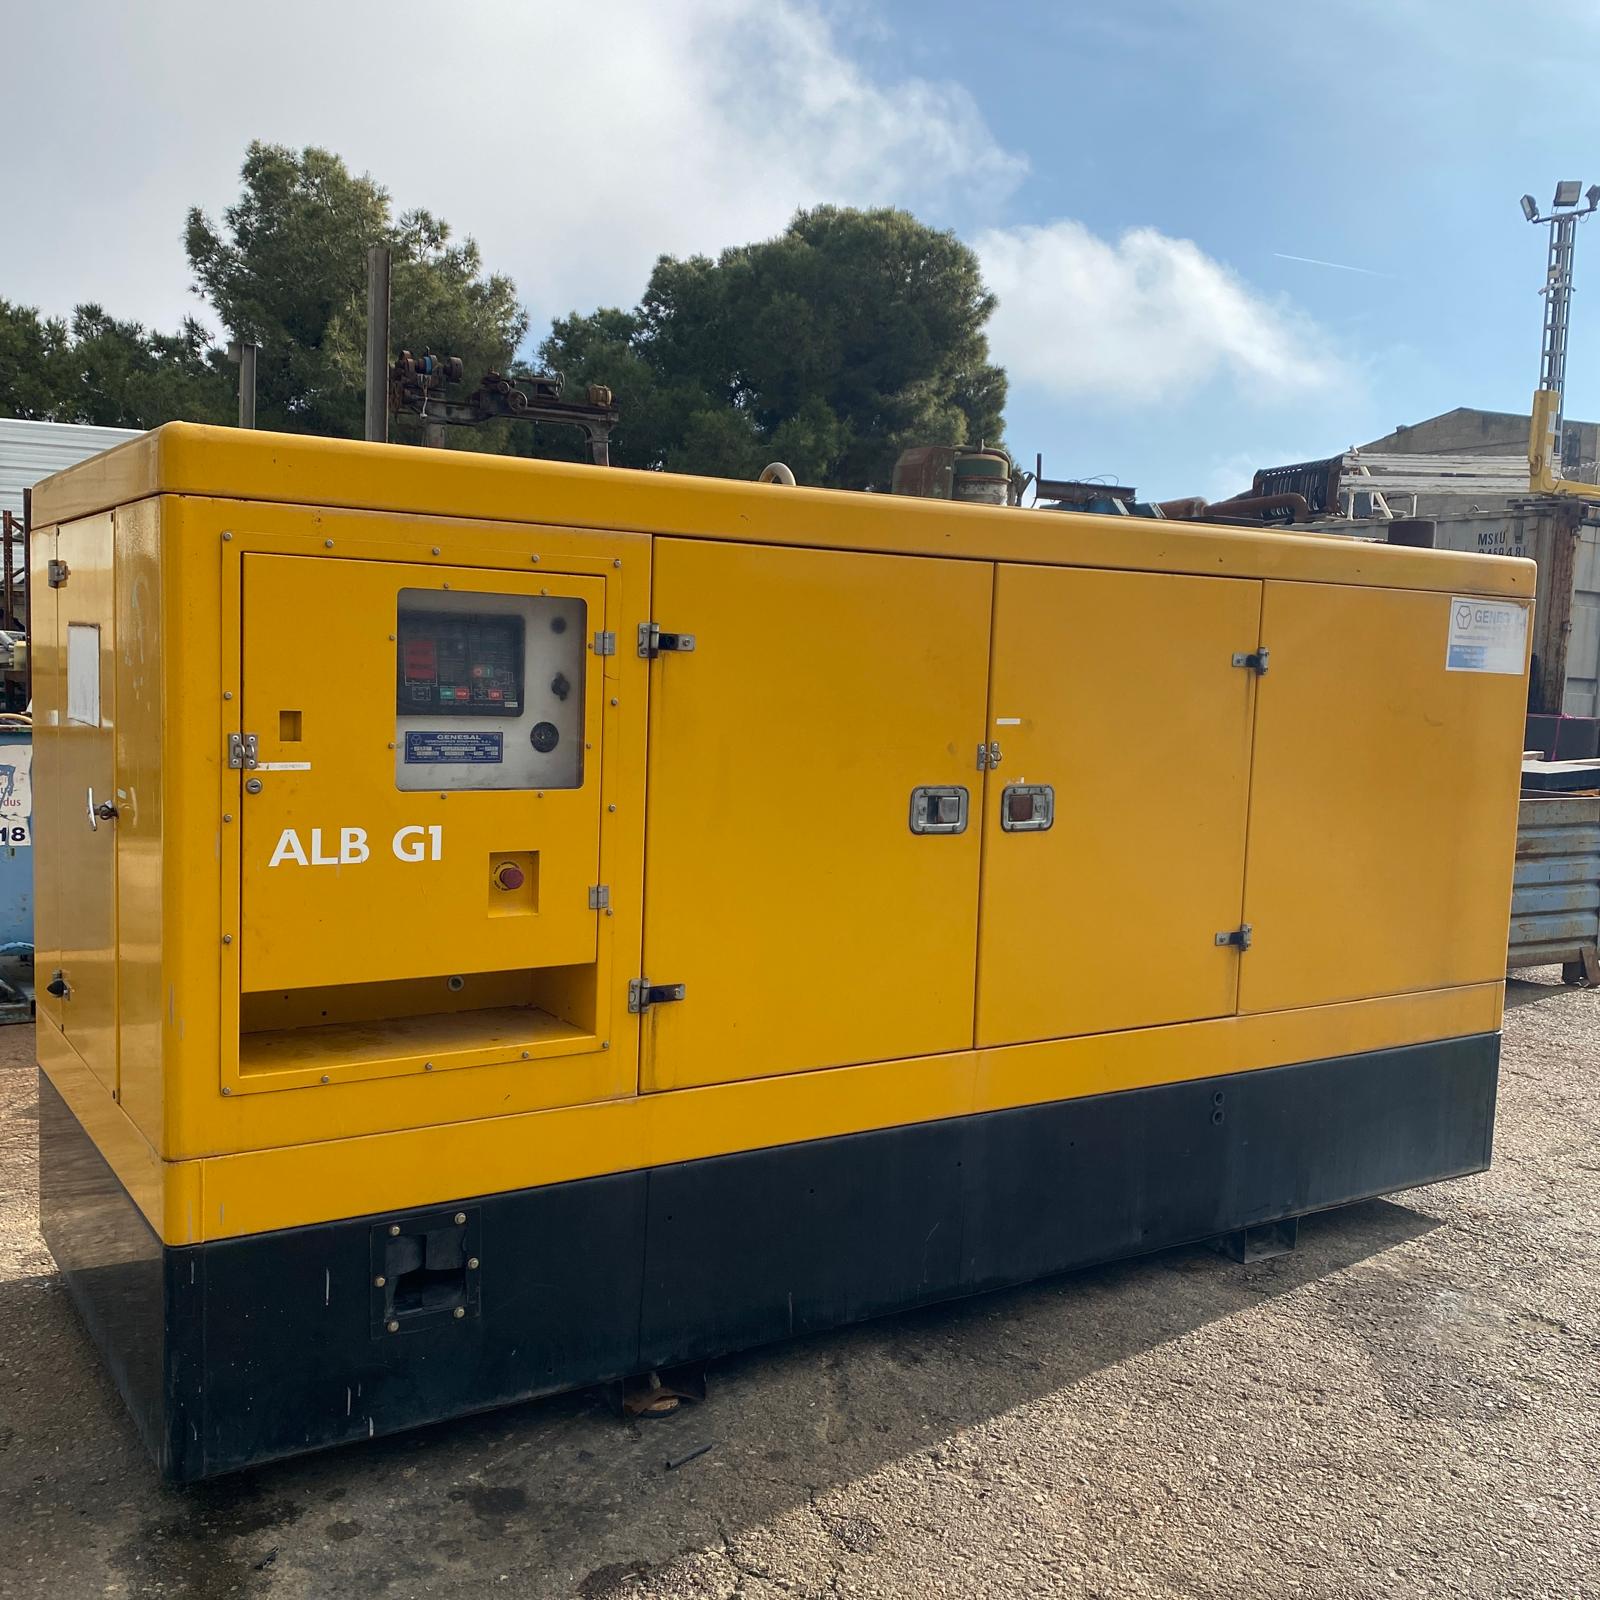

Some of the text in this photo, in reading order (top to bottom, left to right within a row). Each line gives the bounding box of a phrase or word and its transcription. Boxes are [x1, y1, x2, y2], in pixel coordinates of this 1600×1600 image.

[1478, 532, 1505, 546] MSKU
[268, 825, 442, 867] ALB G1
